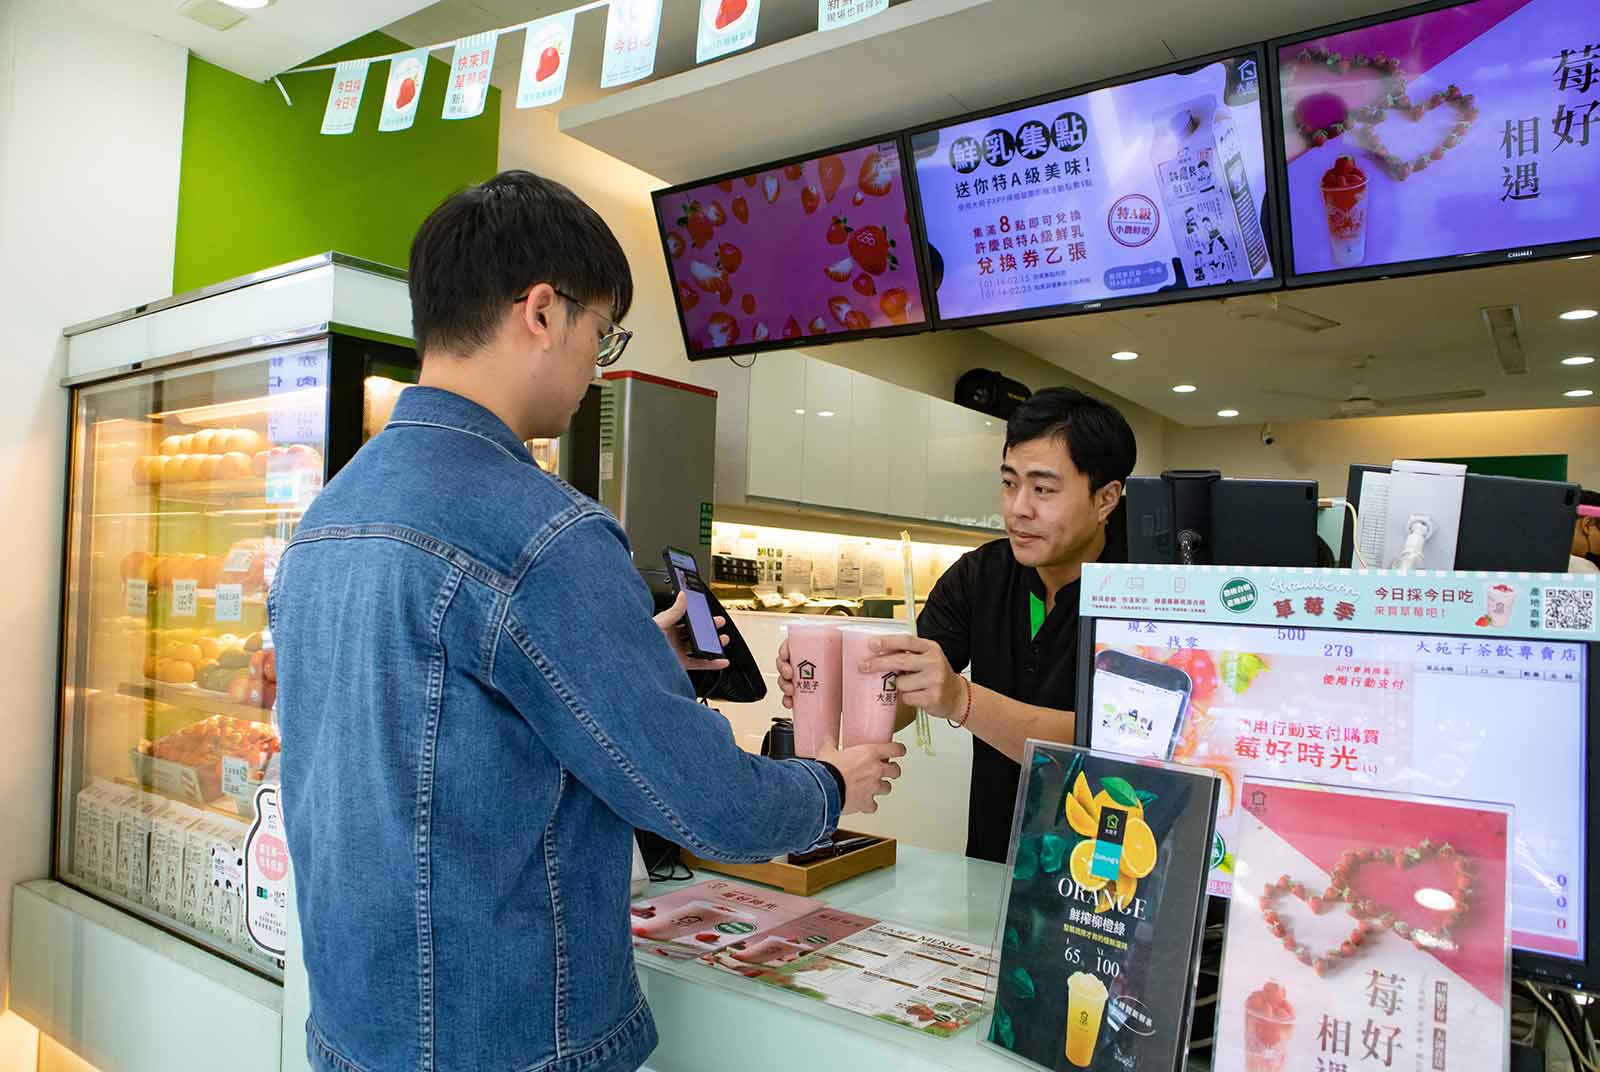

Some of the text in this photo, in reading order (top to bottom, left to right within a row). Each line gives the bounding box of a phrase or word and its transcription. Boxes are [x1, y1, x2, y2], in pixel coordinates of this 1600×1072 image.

[1552, 44, 1600, 152] 莓好
[953, 116, 1084, 171] 鮮乳集點
[1499, 116, 1542, 202] 相遇
[973, 210, 1082, 239] 集滿8點即可兌換
[975, 225, 1085, 254] 許慶良特A級鮮乳
[977, 241, 1087, 275] 兌換券乙張
[1375, 587, 1475, 604] 今日採今日吃
[1272, 595, 1357, 622] 草莓季
[1127, 620, 1158, 633] 現金
[1277, 628, 1306, 641] 500
[1166, 636, 1199, 649] 找零
[1323, 643, 1354, 657] 279
[1416, 640, 1577, 662] 大苑子茶飲專賣店
[1322, 673, 1405, 690] 使用行動支付
[1234, 735, 1359, 772] 莓好時光
[1556, 874, 1567, 887] 0
[1057, 877, 1148, 921] ORANGE
[1556, 896, 1567, 908] 0
[1556, 918, 1567, 930] 0
[1064, 946, 1081, 964] 65
[1096, 956, 1120, 978] 100
[1361, 968, 1408, 1067] 莓好
